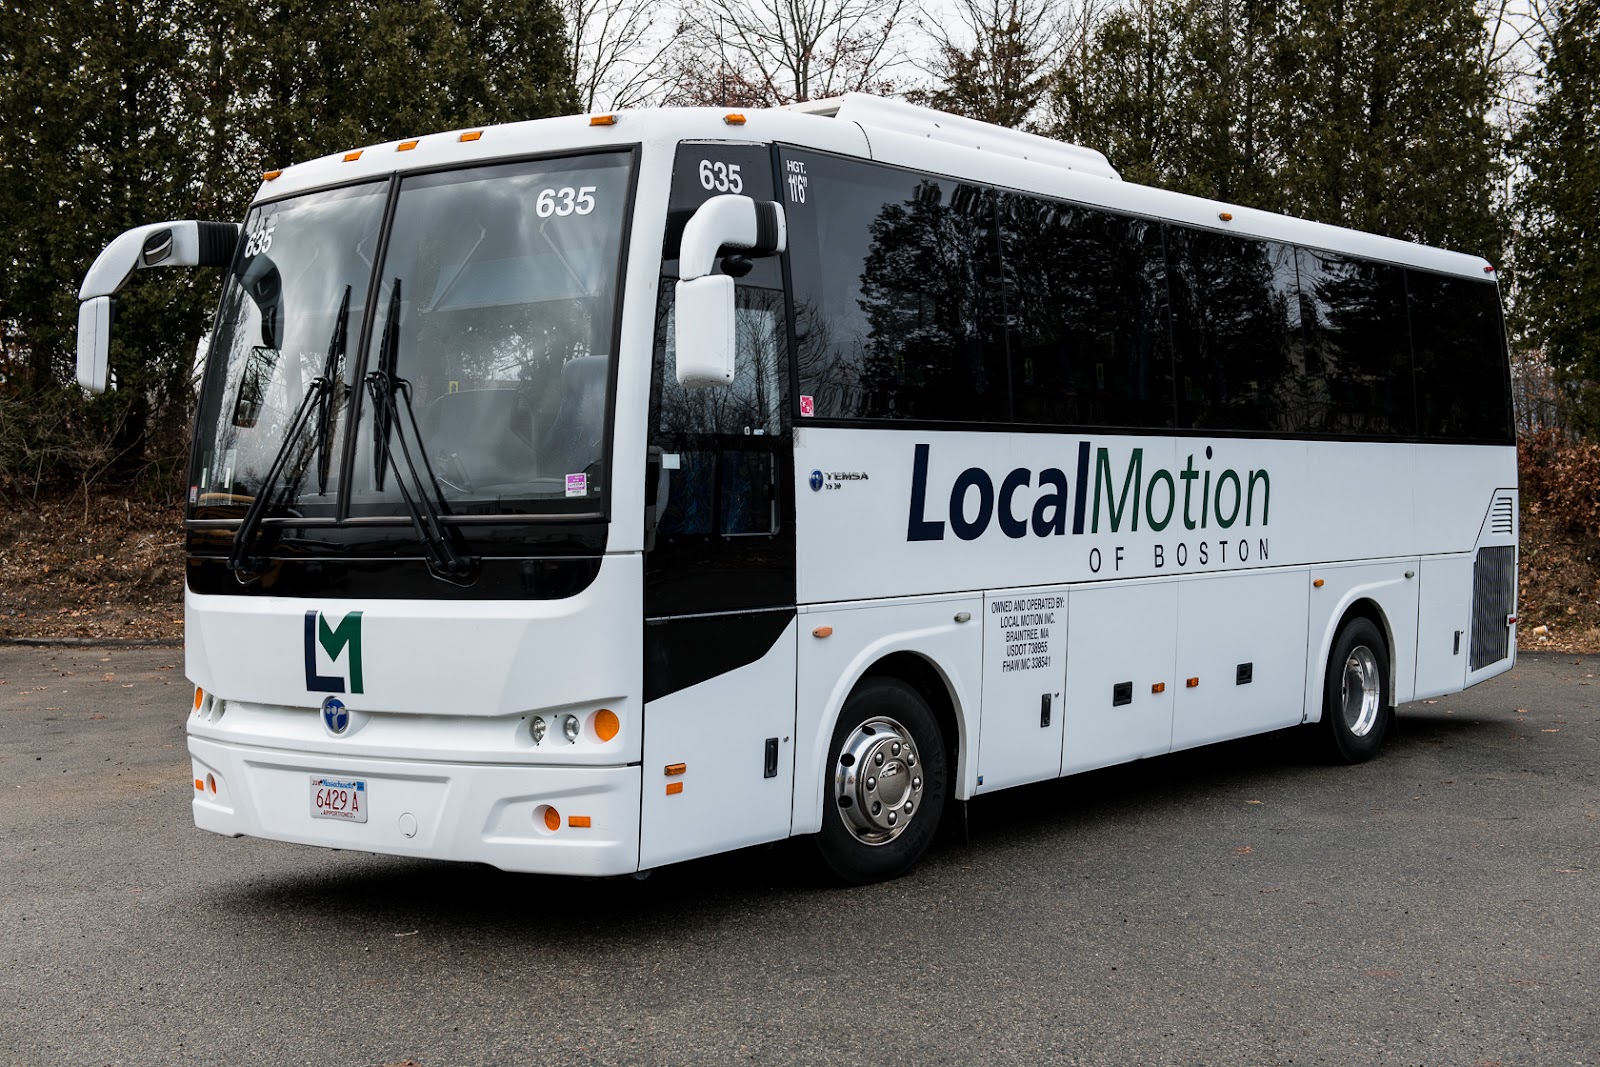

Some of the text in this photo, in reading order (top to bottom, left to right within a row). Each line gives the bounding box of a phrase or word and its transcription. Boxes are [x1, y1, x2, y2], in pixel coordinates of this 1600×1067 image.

[786, 160, 807, 174] HGT.
[699, 159, 743, 194] 635
[535, 186, 597, 218] 635
[244, 227, 275, 258] 635
[825, 471, 869, 481] TEMSA
[907, 441, 1270, 542] LocalMotion
[1089, 538, 1269, 573] OF BOSTON
[991, 597, 1065, 614] OWNED AND OPERATED BY:
[1000, 612, 1055, 629] LOCAL MOTION INC.
[1006, 628, 1049, 642] BRAINTREE, MA
[1006, 641, 1048, 657] USDOT 738955
[1031, 656, 1051, 670] 338541
[316, 788, 359, 812] 6429 A
